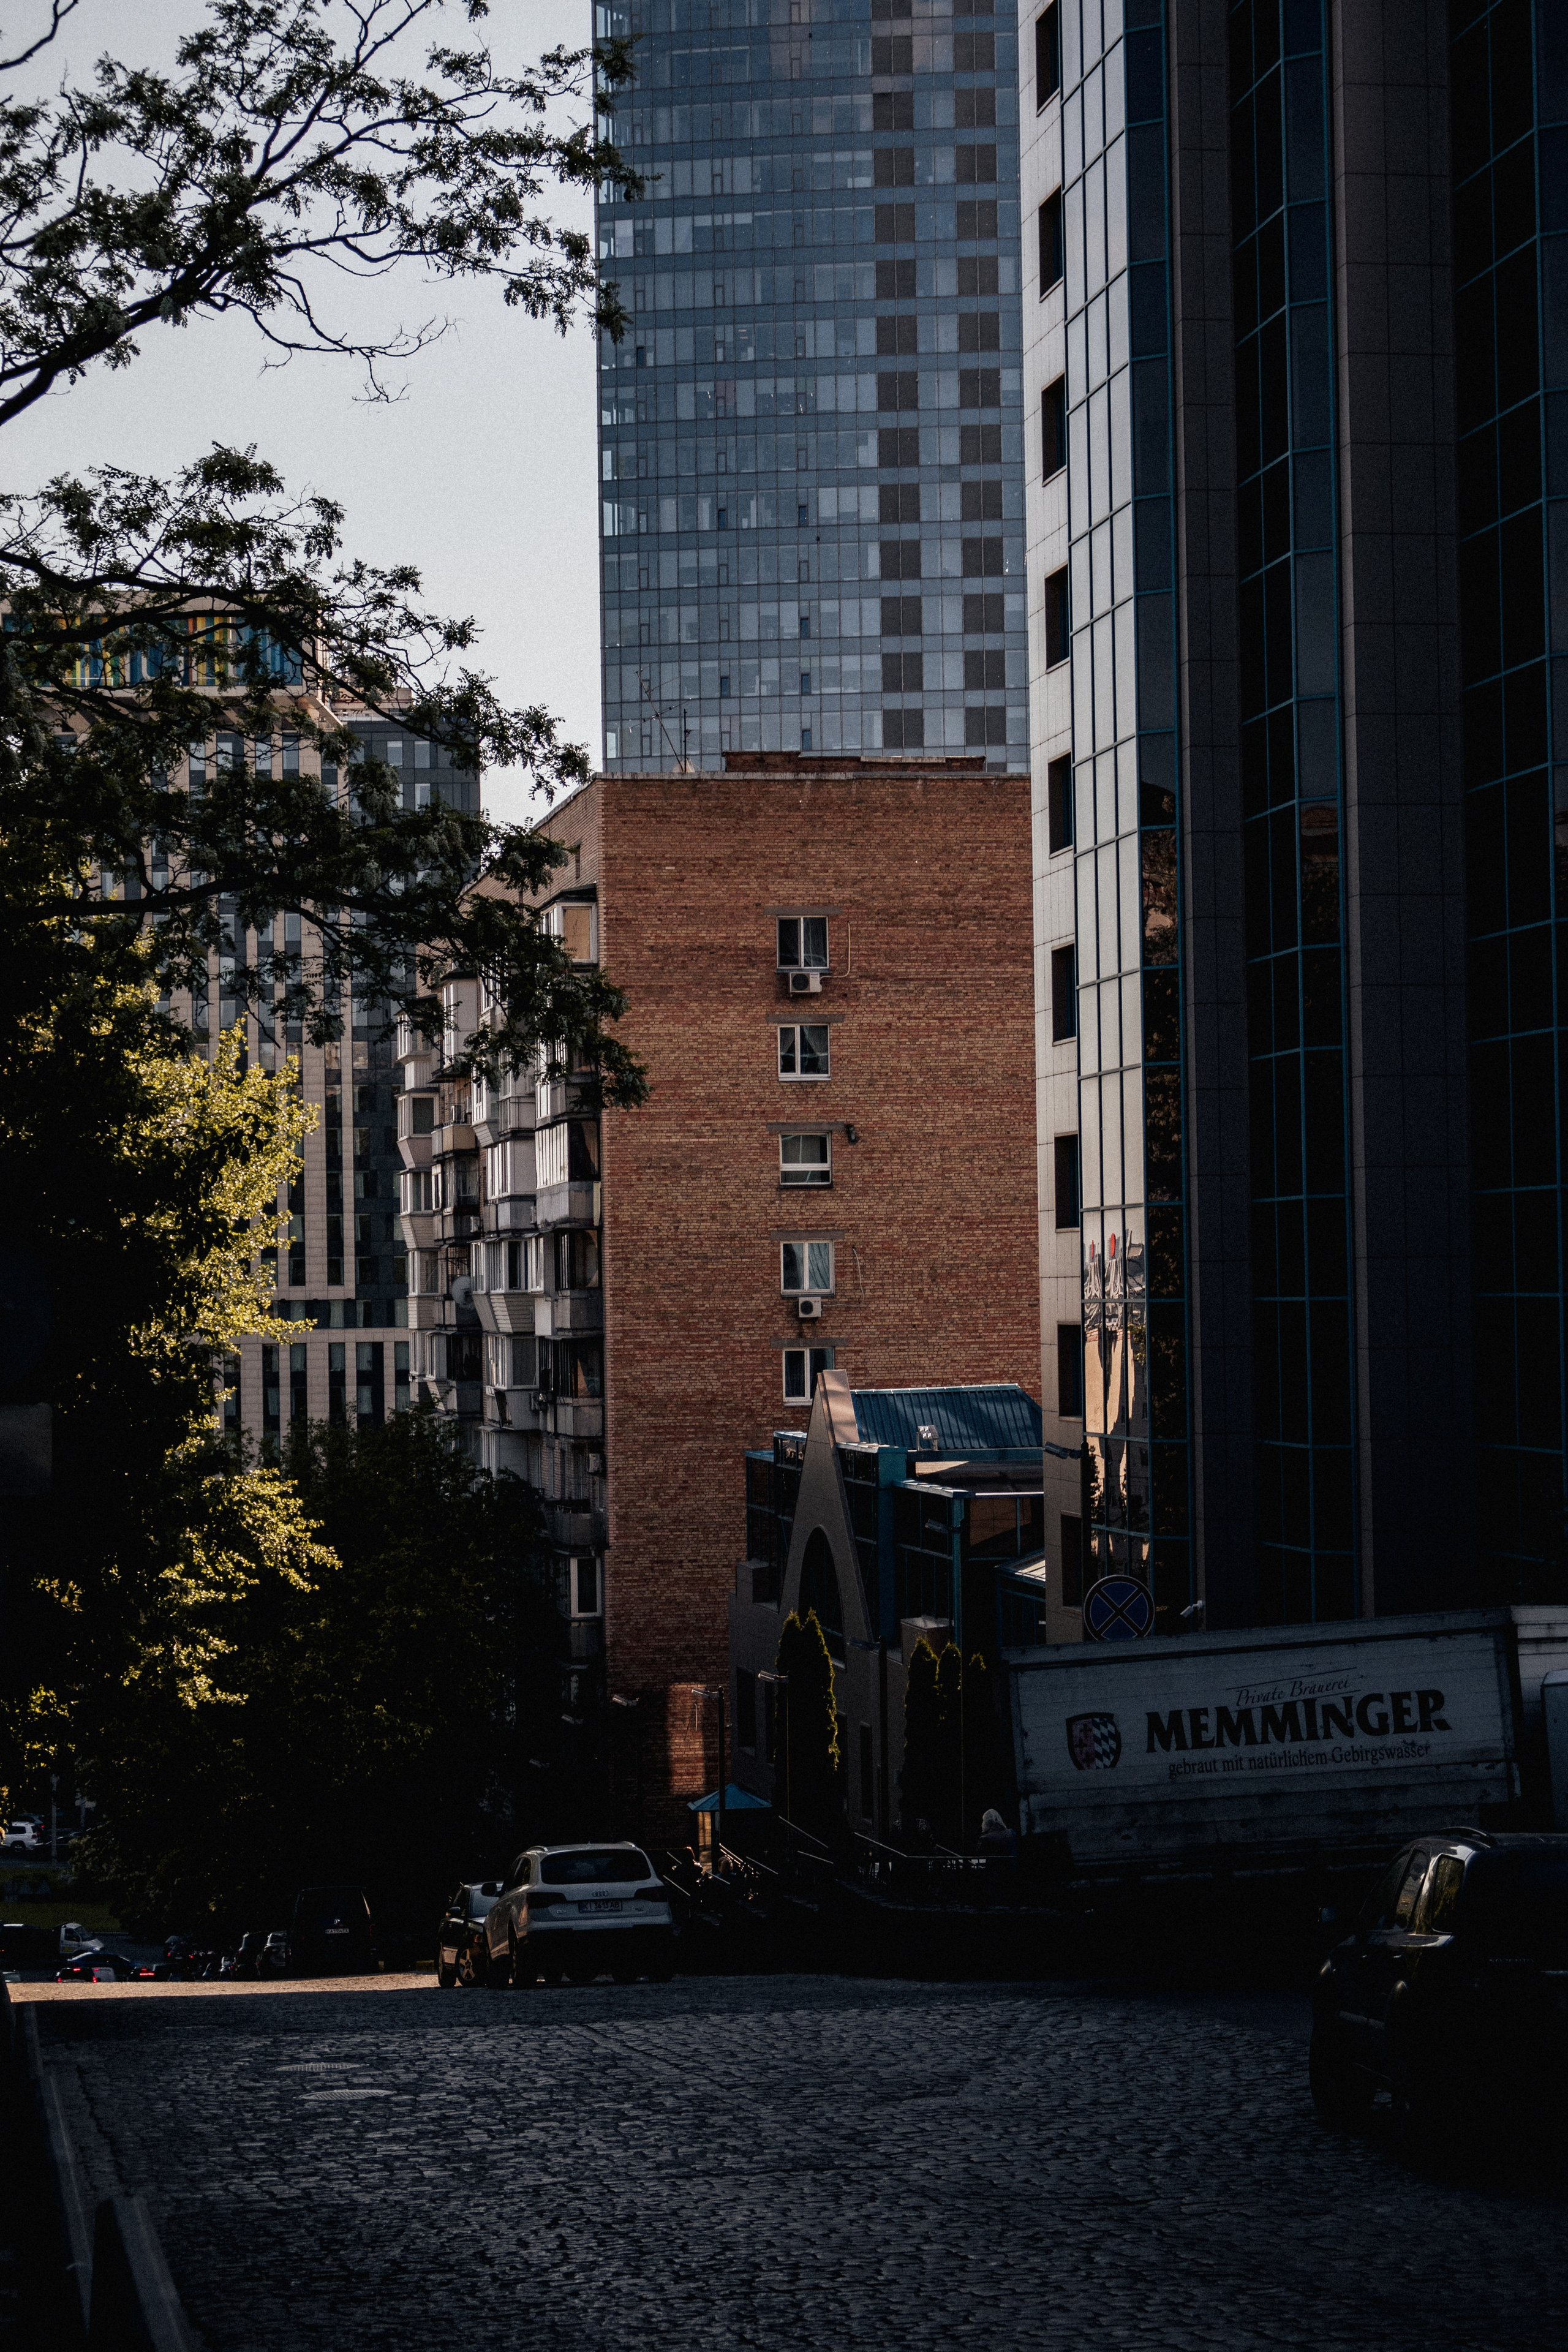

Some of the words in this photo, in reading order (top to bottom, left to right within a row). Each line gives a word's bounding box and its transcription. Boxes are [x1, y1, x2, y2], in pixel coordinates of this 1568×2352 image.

[1235, 1686, 1286, 1708] Private
[1290, 1674, 1351, 1697] Brauerei
[1145, 1689, 1453, 1753] MEMMINGER
[1168, 1758, 1218, 1781] gebraut
[1222, 1754, 1244, 1772] mit
[1248, 1748, 1328, 1770] natürlichem
[1331, 1741, 1431, 1768] Gebirgswasser
